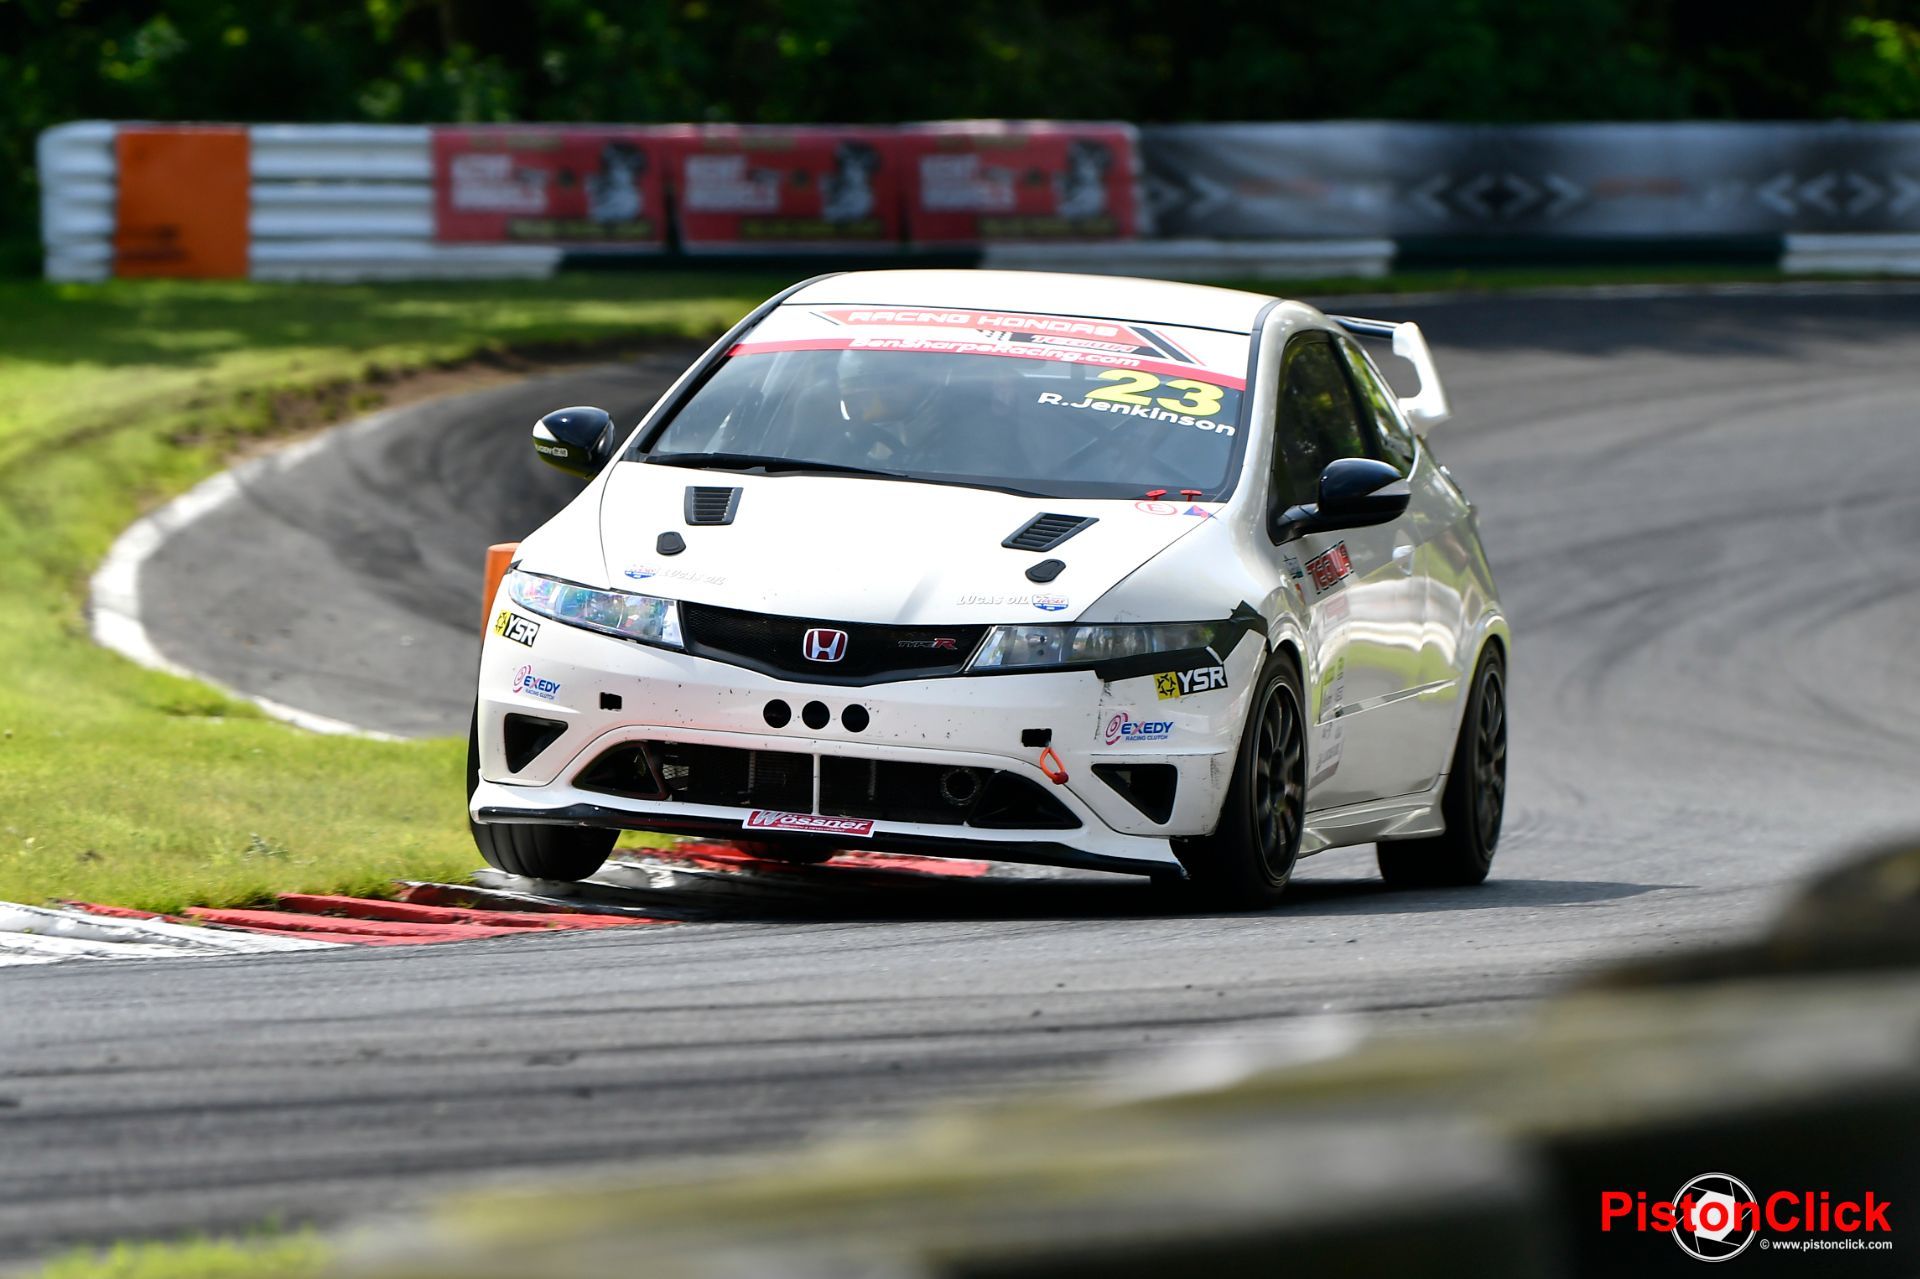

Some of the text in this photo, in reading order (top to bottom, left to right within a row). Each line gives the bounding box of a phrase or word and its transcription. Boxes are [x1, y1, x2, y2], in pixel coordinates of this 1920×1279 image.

[848, 311, 1119, 337] RACING HONDAS
[848, 337, 1141, 367] BenSharpeRacing.com
[1084, 368, 1225, 416] 23
[1037, 392, 1236, 437] R.Jenkinson
[956, 593, 1004, 606] LUCAS
[1007, 593, 1029, 605] OIL
[504, 614, 540, 647] YSR
[523, 675, 561, 694] EXEDY
[1178, 666, 1226, 693] YSR
[1121, 721, 1174, 735] EXEDY
